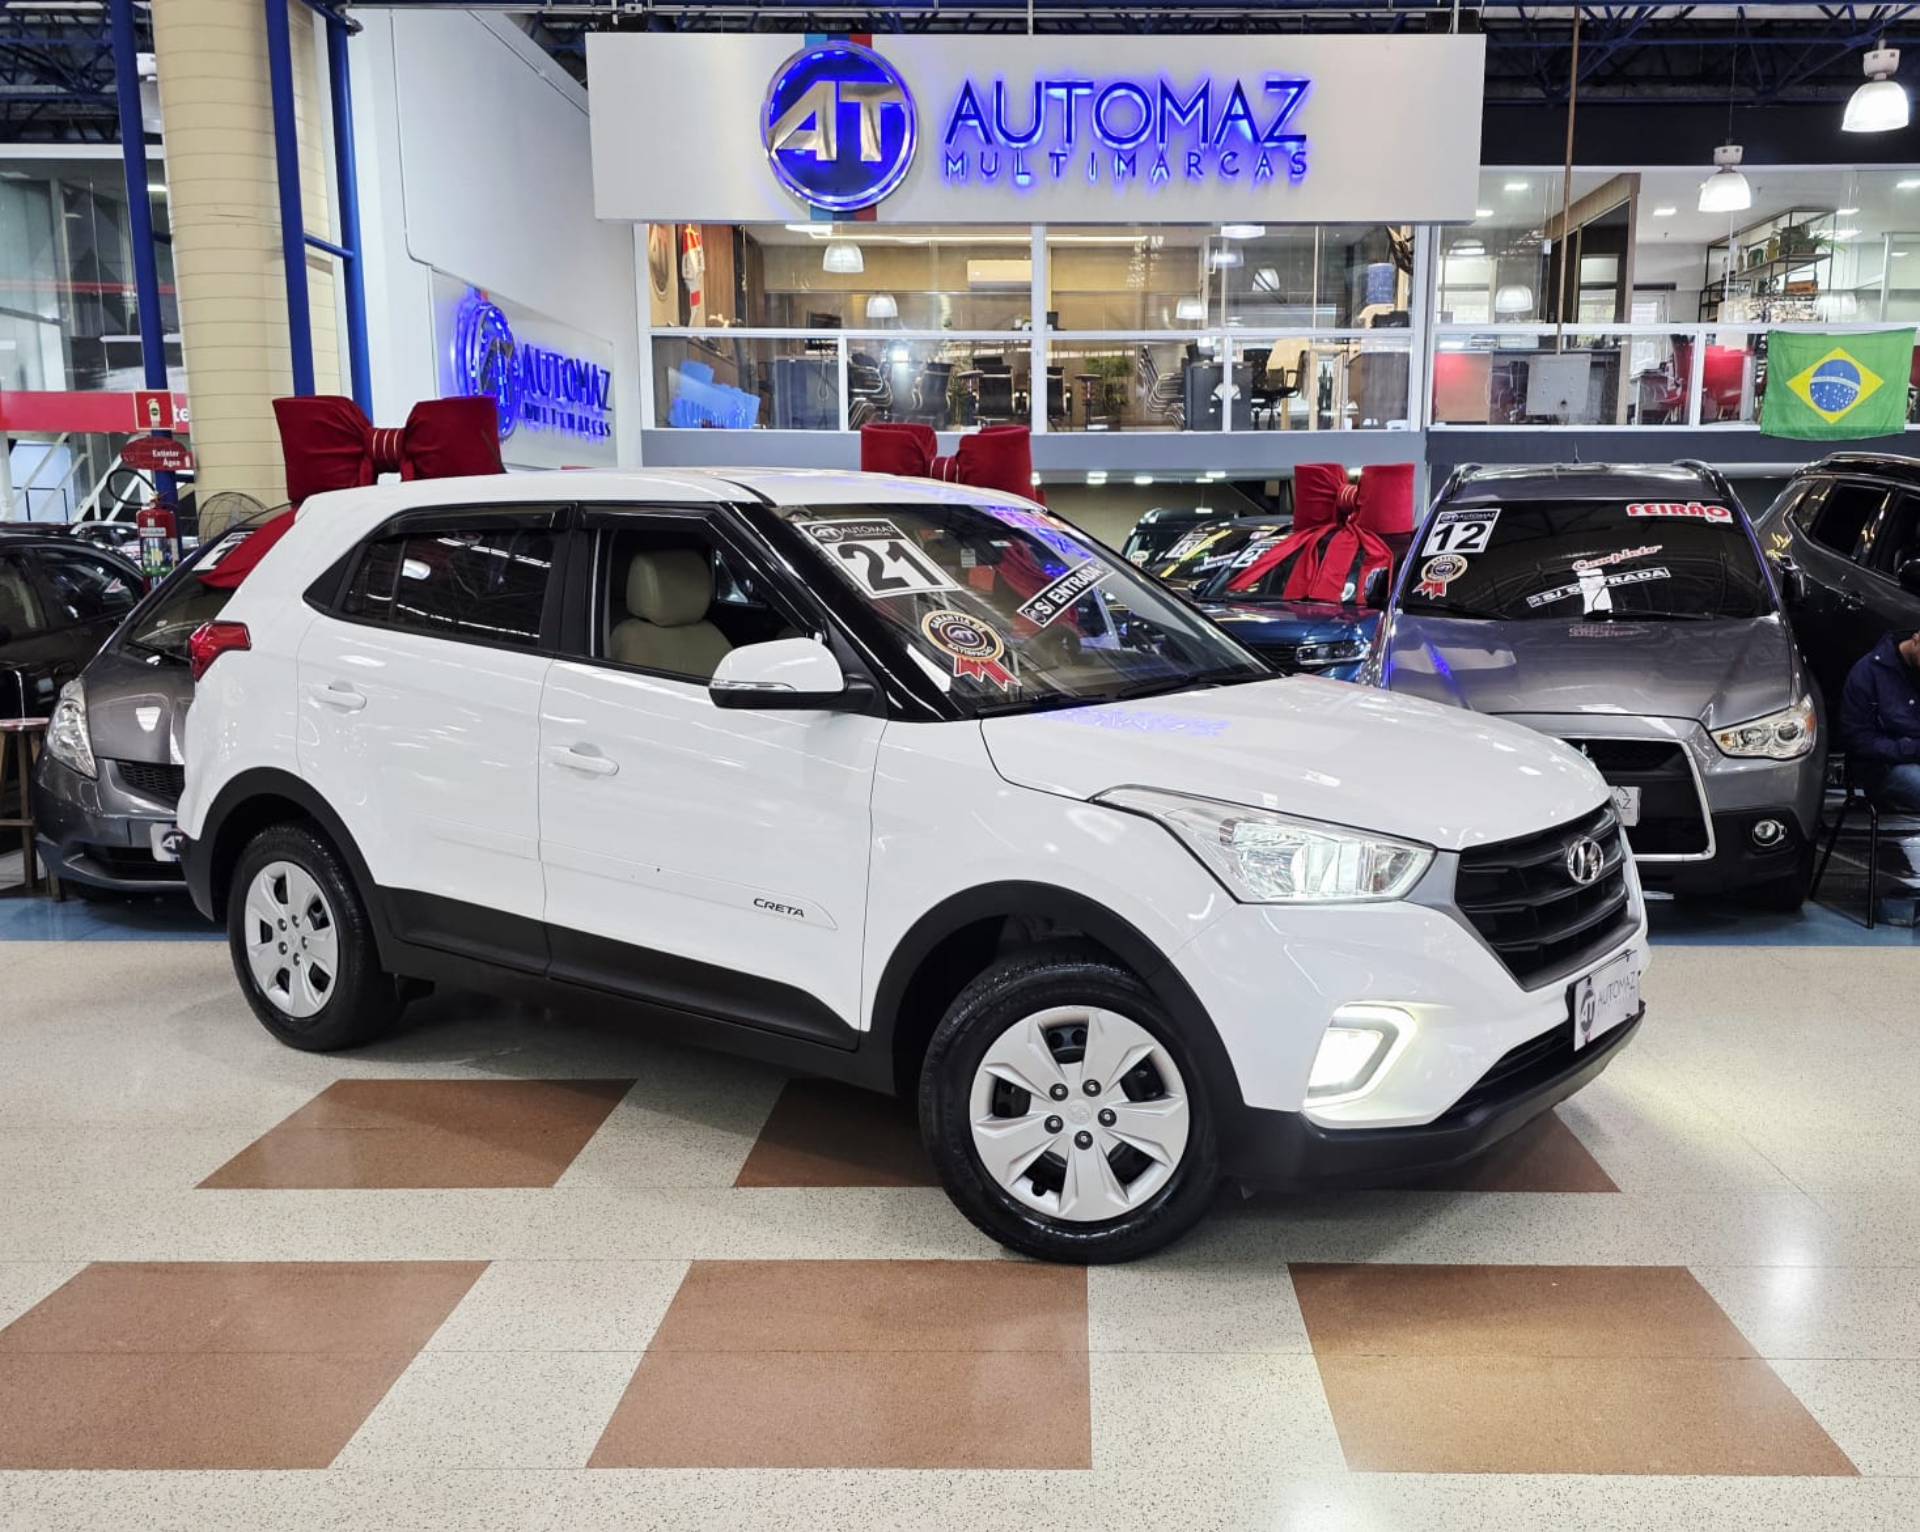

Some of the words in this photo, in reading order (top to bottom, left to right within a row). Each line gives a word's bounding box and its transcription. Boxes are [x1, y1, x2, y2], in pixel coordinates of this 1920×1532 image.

[945, 79, 1311, 146] AUTOMAZ
[945, 151, 1308, 178] MULTIMARCAS
[522, 343, 612, 411] AUTOMAZ
[1628, 503, 1730, 518] FEIRÃO
[1434, 523, 1487, 551] 12
[837, 541, 944, 591] 21
[753, 898, 805, 918] CRETA
